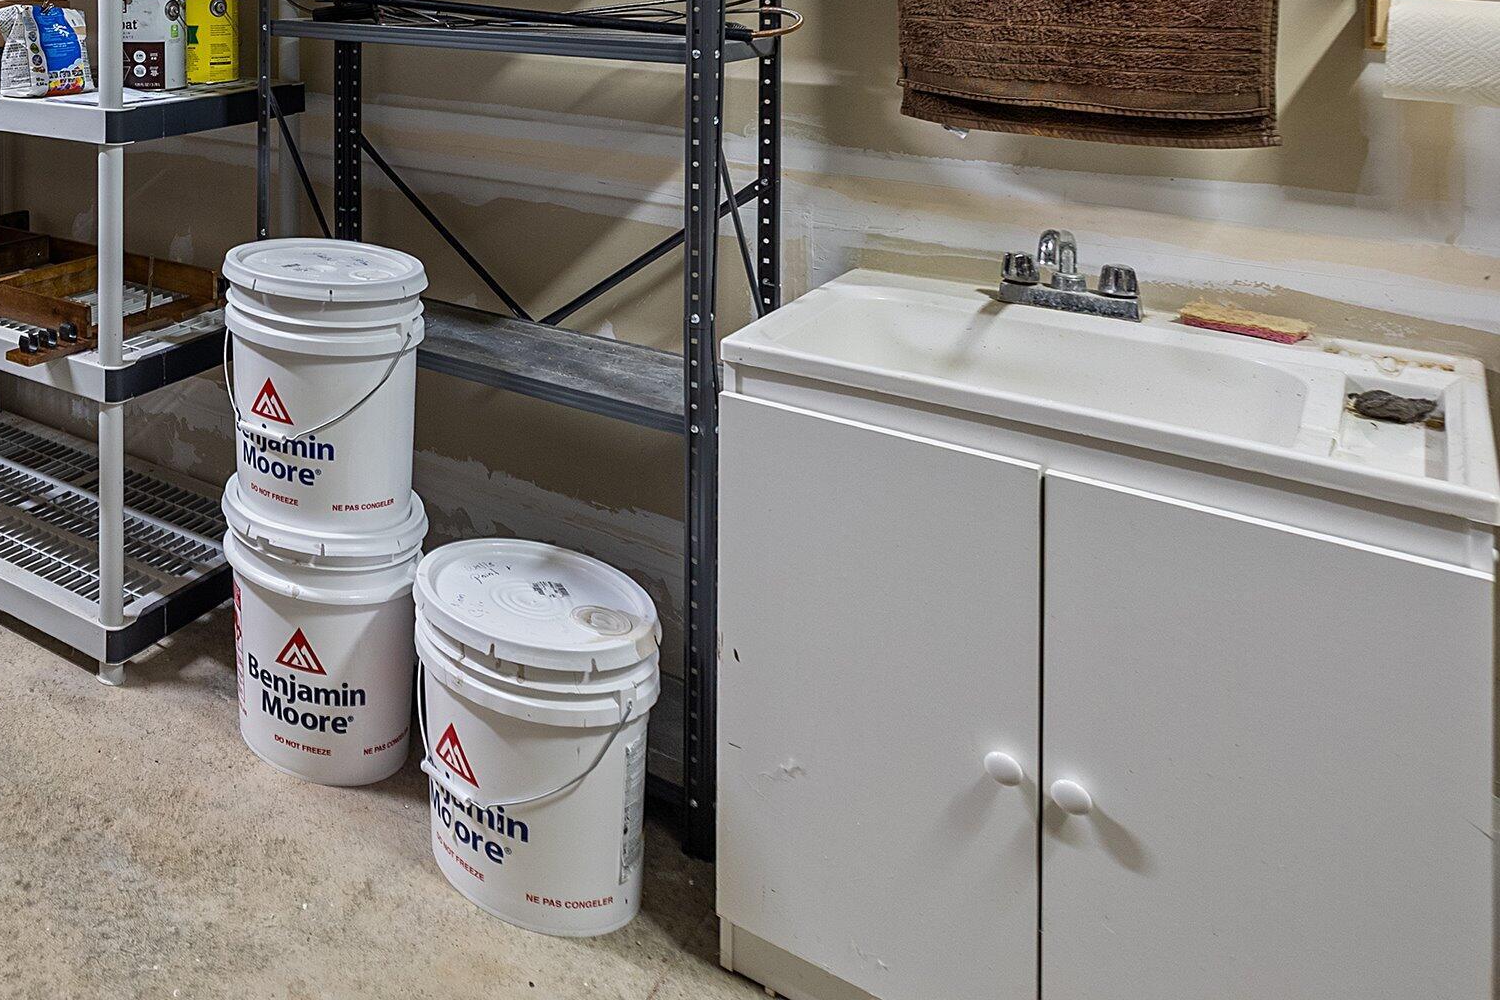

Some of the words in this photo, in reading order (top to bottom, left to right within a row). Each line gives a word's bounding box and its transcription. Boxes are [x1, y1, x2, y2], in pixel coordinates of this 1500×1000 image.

[259, 487, 271, 498] NOT
[272, 494, 299, 507] FREEZE
[332, 504, 343, 512] NE
[361, 498, 394, 510] CONGELER
[248, 652, 366, 707] Benjamin
[274, 734, 284, 744] DO
[285, 739, 301, 750] NOT
[302, 745, 332, 757] FREEZE
[456, 855, 485, 882] FREEZE
[525, 893, 540, 905] NE
[542, 897, 562, 908] PAS
[564, 896, 614, 910] CONGELER
